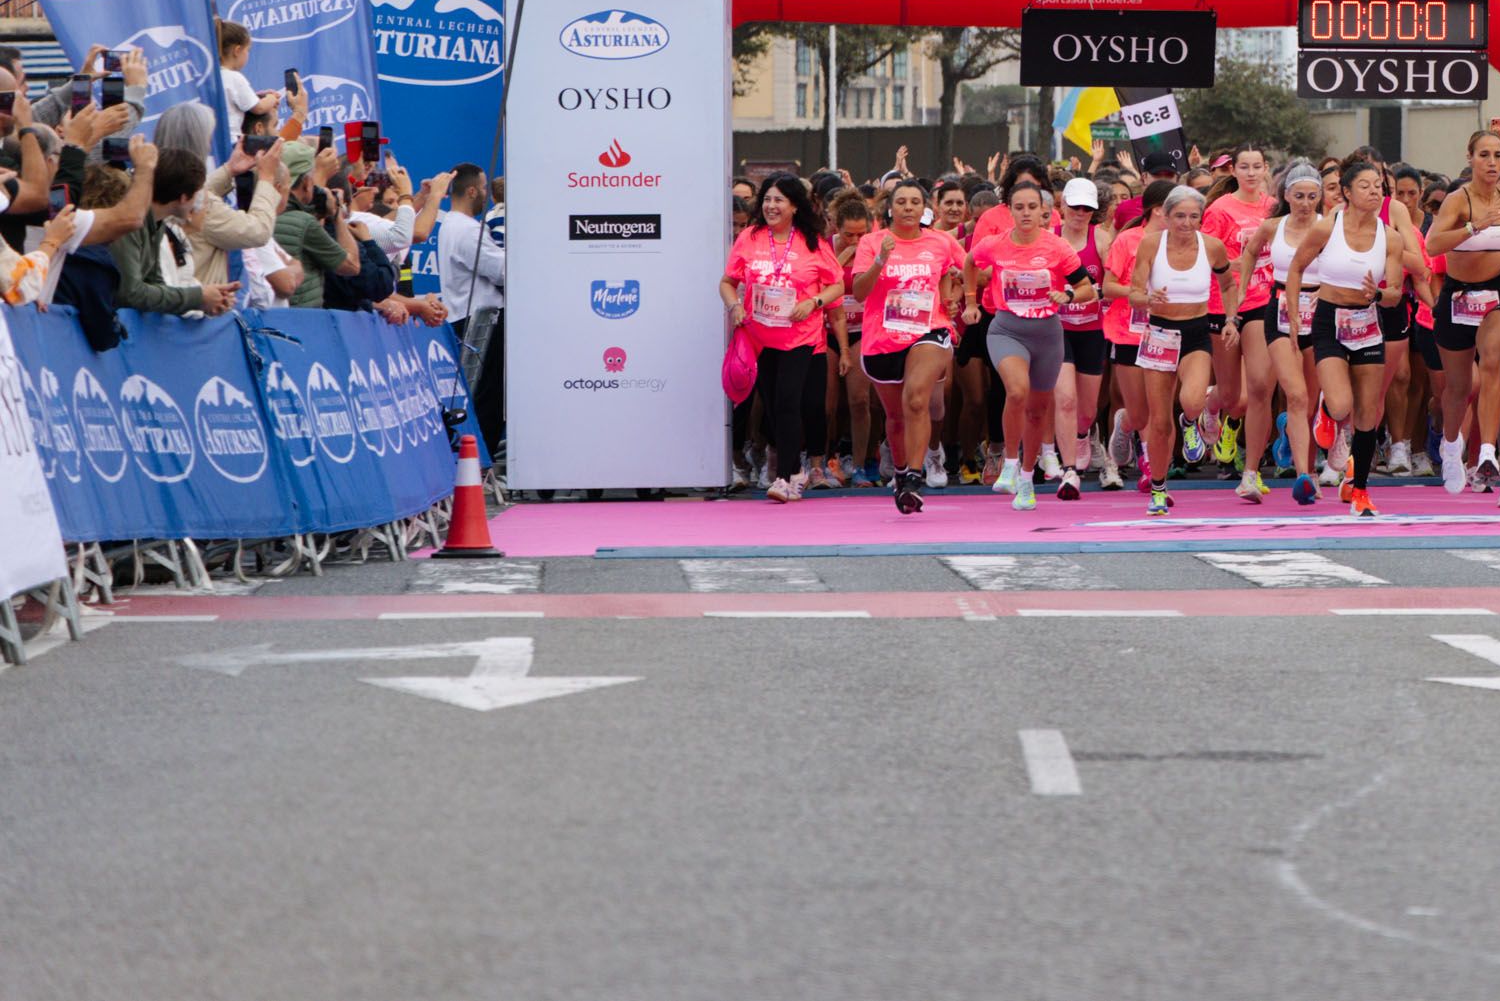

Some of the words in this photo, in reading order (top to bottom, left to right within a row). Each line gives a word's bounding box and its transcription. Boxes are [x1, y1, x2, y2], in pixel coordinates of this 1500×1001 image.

[376, 14, 433, 29] ENTRAL
[439, 20, 500, 36] LECHERA
[372, 29, 501, 65] TURIANA
[568, 28, 662, 48] ASTURIANA
[1052, 33, 1189, 65] OYSHO
[1306, 56, 1480, 95] OYSHO
[558, 86, 672, 111] OYSHO
[567, 171, 662, 188] Santander
[575, 219, 656, 238] Neutrogena
[886, 263, 932, 278] CARRERA
[593, 287, 638, 310] Marlene
[563, 378, 619, 392] octopus
[620, 377, 667, 392] energy
